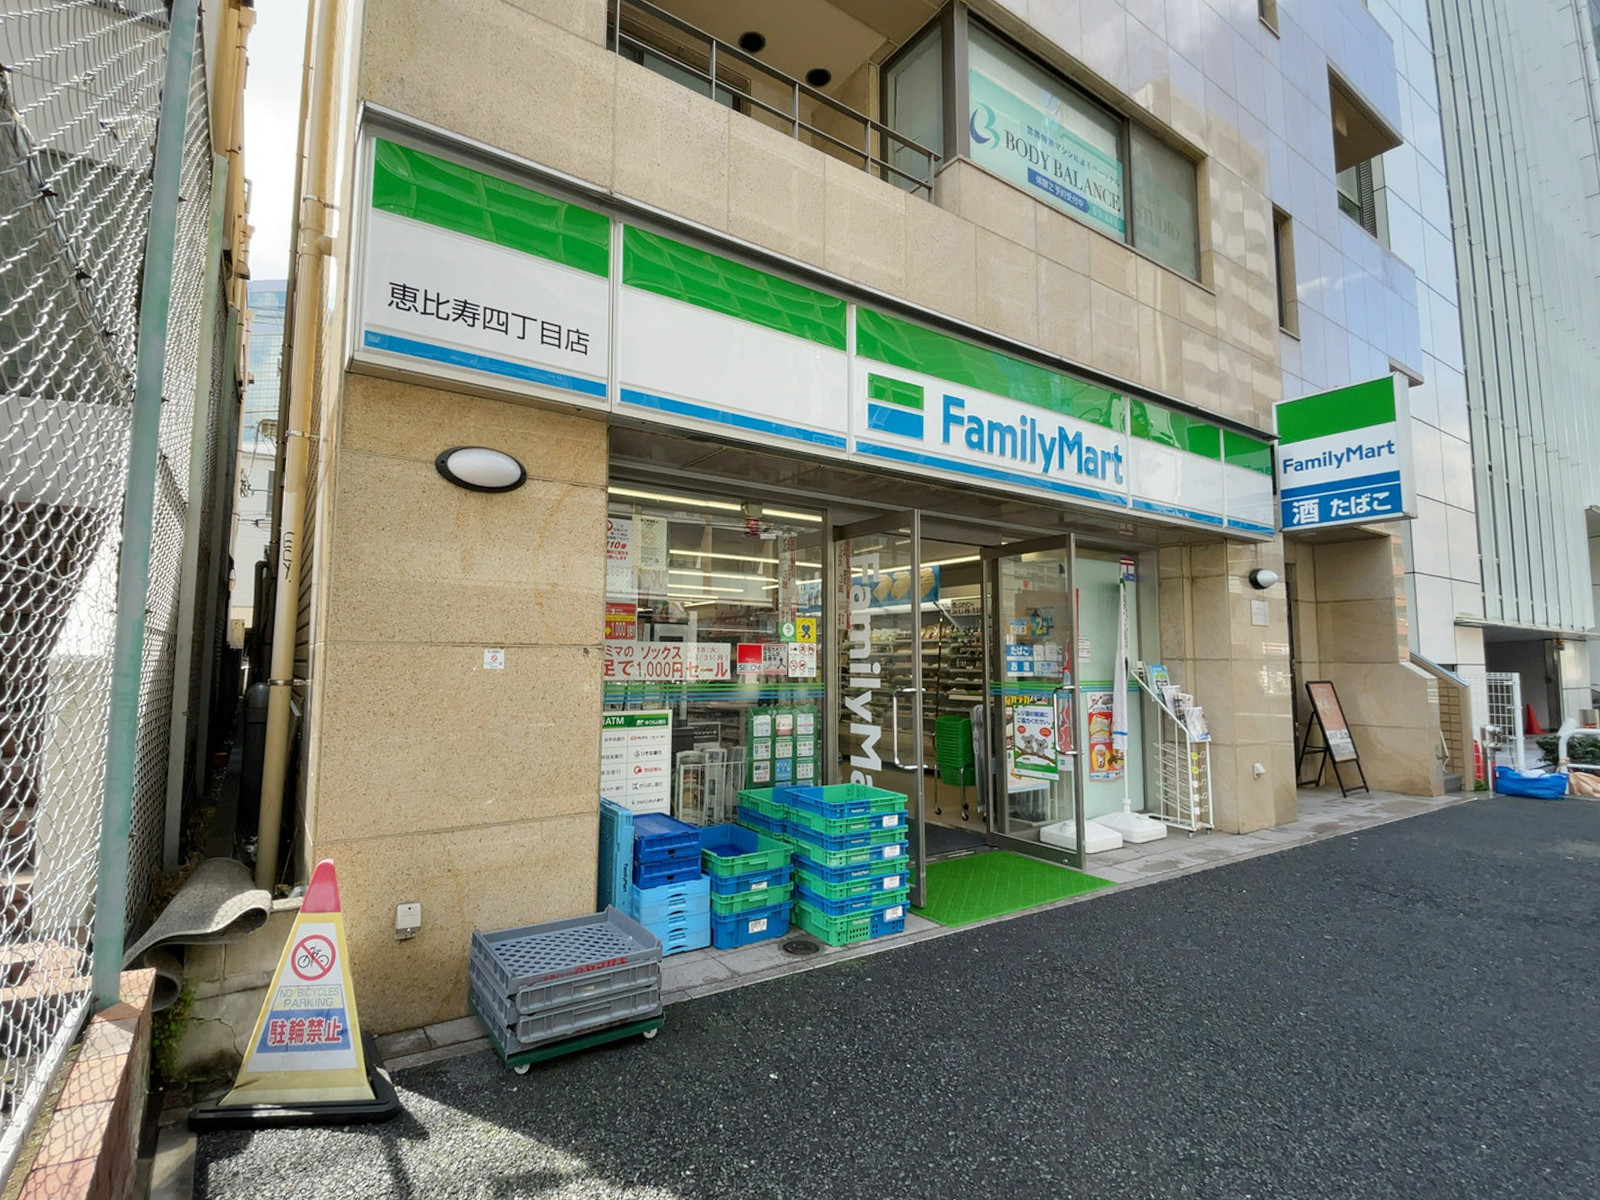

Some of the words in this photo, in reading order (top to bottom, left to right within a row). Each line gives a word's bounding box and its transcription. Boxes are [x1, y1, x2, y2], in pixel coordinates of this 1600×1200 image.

[1004, 130, 1050, 172] BODY
[1053, 158, 1121, 212] BALANCE
[387, 281, 590, 356] 恵比寿四丁目店
[942, 394, 1124, 485] FamilyMart
[1282, 440, 1396, 474] FamilyMart
[1292, 498, 1320, 525] 酒
[1330, 491, 1392, 517] たばこ
[279, 988, 293, 998] NO
[297, 986, 339, 998] BICYCLES
[283, 997, 334, 1008] PARKING
[267, 1016, 343, 1047] 駐輪禁止
